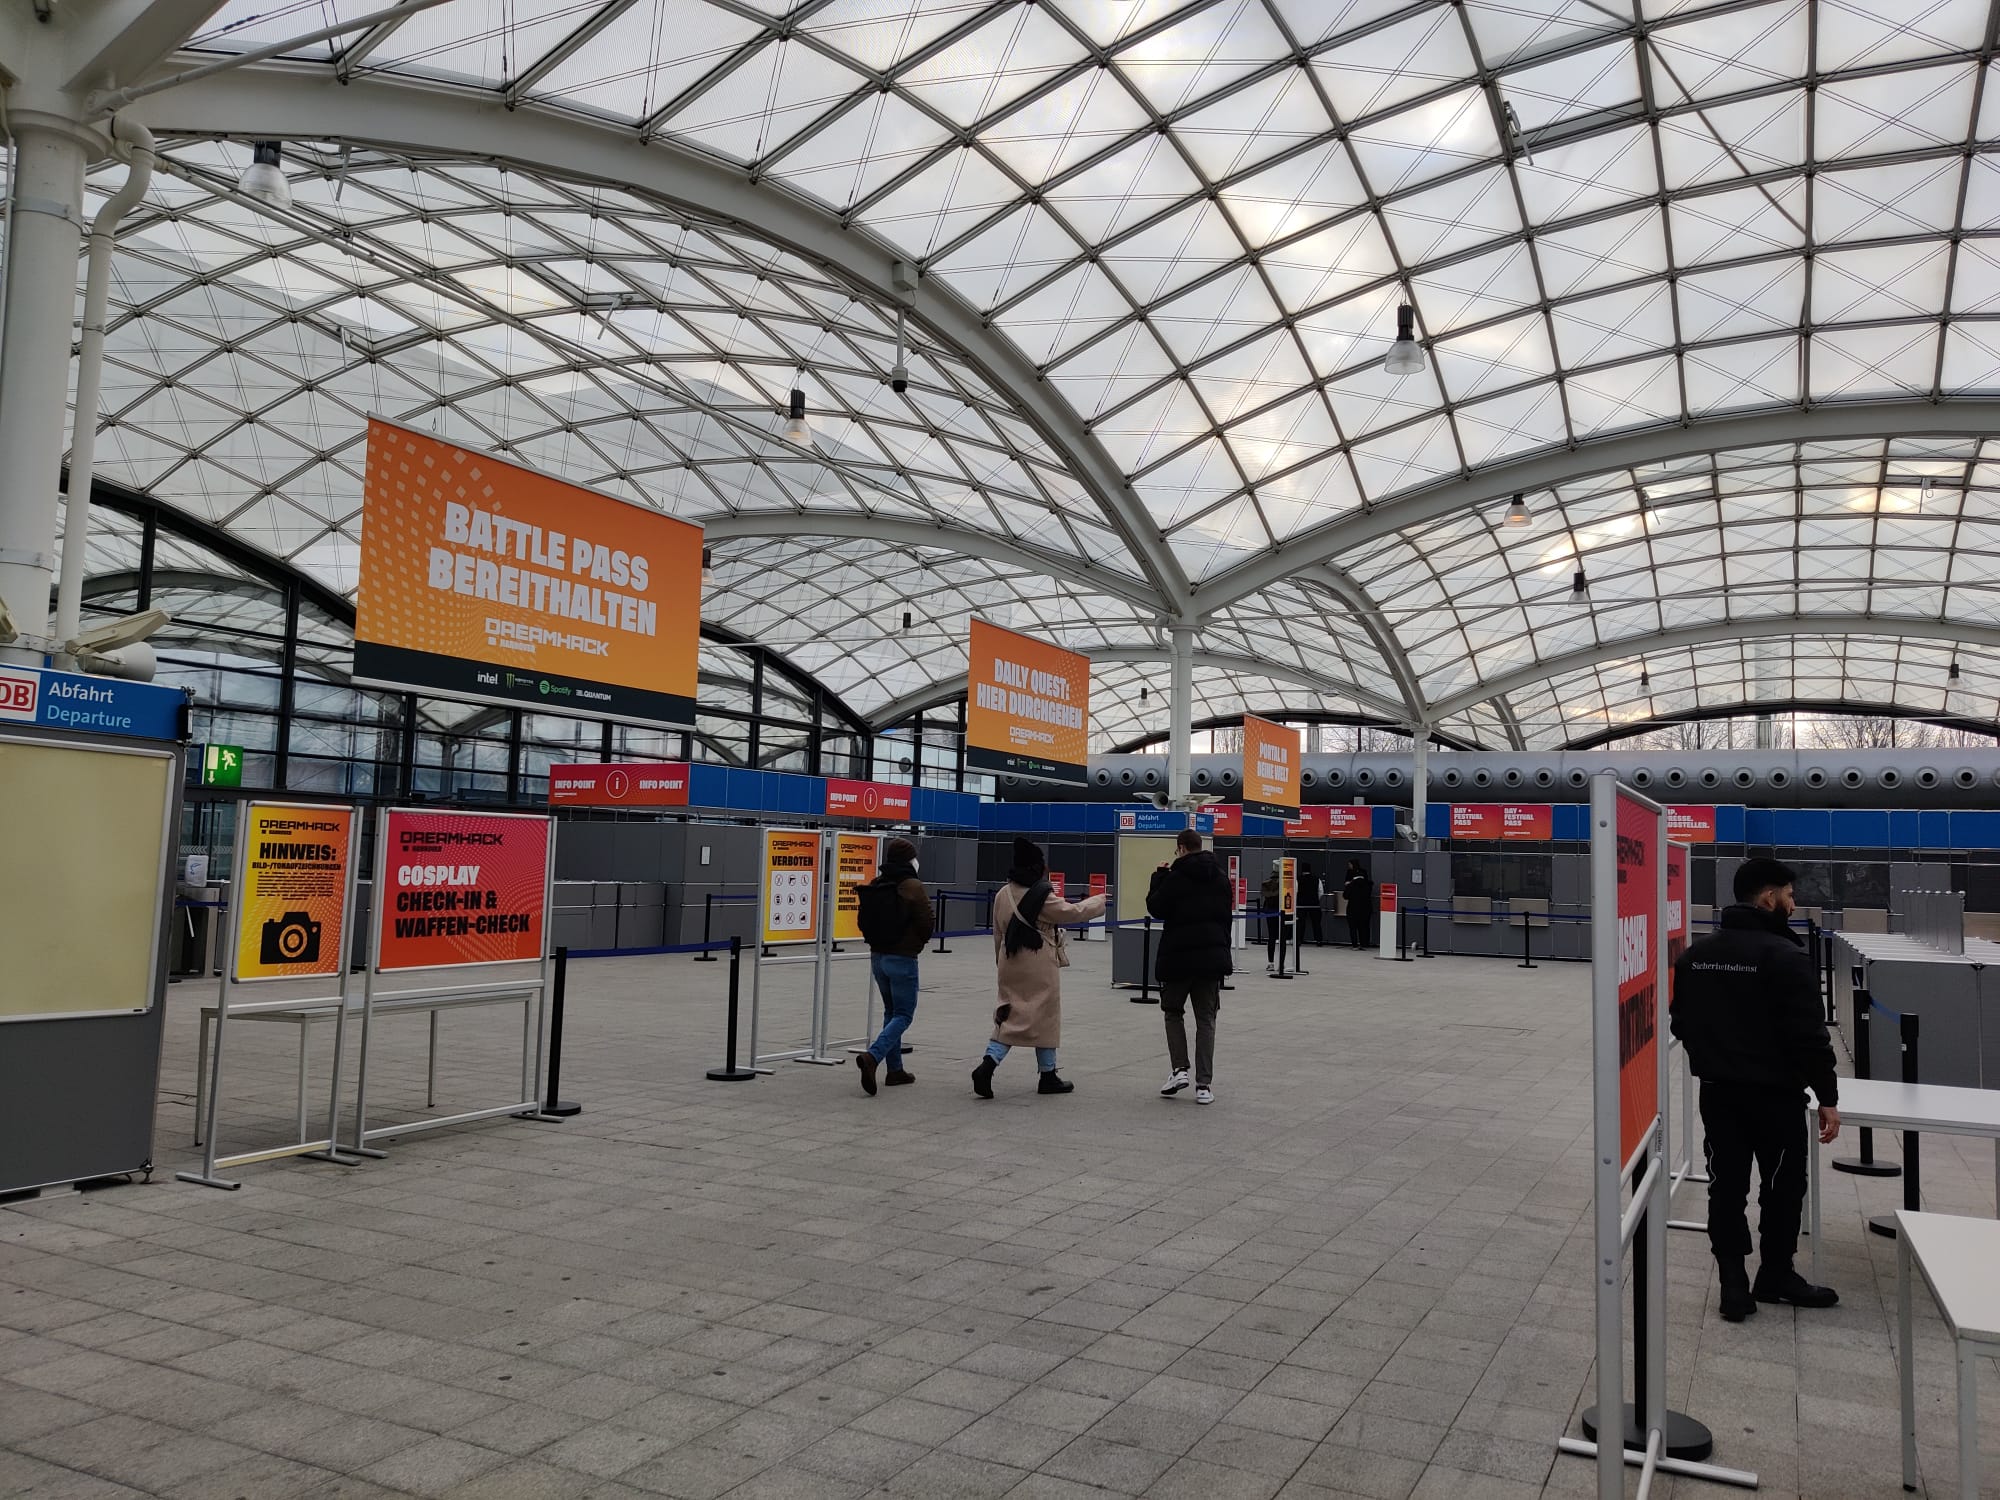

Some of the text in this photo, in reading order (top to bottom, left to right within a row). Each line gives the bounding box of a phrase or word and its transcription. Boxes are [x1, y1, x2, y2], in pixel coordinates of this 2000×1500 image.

[445, 501, 649, 591] BATTLE PASS
[428, 547, 656, 636] BEREITHALTEN
[485, 618, 609, 656] DREAMHACK
[477, 671, 498, 685] intel
[551, 685, 572, 696] Spotify
[994, 658, 1070, 700] DAILY QUEST:
[0, 683, 30, 706] DB
[48, 682, 114, 704] Abfahrt
[48, 705, 131, 728] Departure
[977, 682, 1082, 729] HIER DURCHGEHEN
[1259, 742, 1280, 762] PORTAL
[1274, 764, 1289, 782] WELT
[555, 780, 596, 789] INFO POINT
[640, 780, 683, 789] INFO POINT
[260, 820, 340, 832] DREAMHACK
[1122, 817, 1133, 825] DB
[400, 832, 504, 845] DREAMHACK
[260, 842, 336, 860] HINWEIS:
[772, 856, 813, 866] VERBOTEN
[398, 865, 480, 886] COSPLAY
[397, 890, 497, 912] CHECK-IN &
[395, 914, 530, 938] WAFFEN-CHECK
[1618, 914, 1648, 986] ASCHEN
[1692, 962, 1757, 973] Sicherheitsdienst
